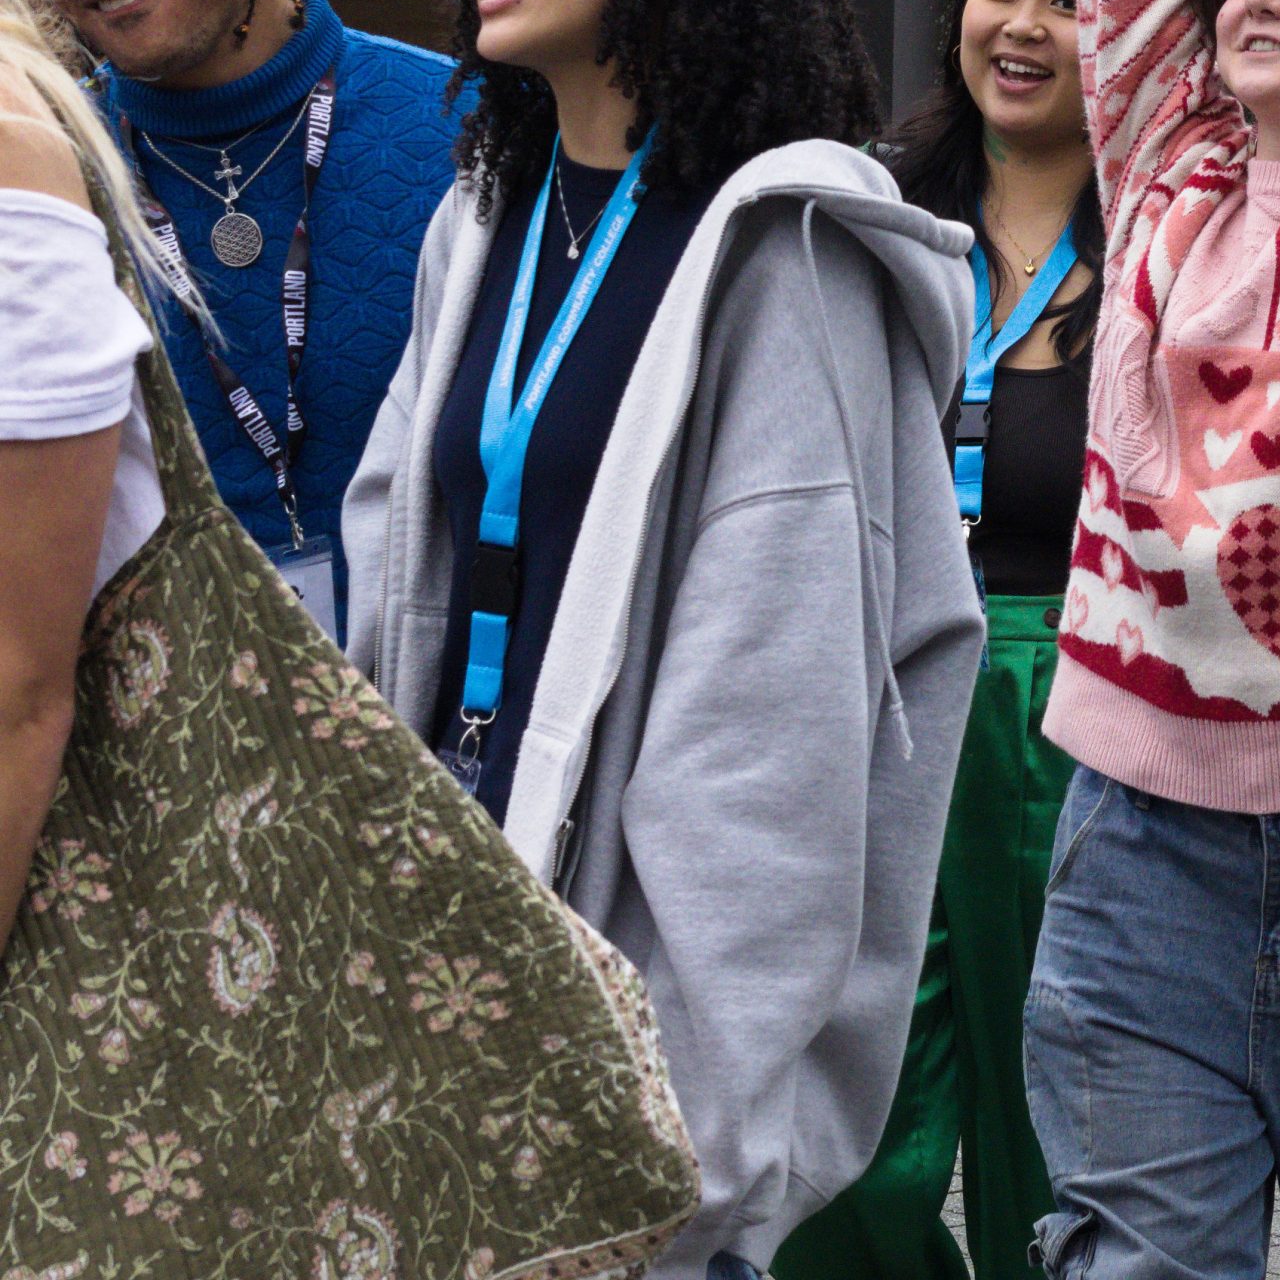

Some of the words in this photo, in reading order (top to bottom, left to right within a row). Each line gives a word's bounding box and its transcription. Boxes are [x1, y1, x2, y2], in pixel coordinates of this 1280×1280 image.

[306, 94, 333, 168] PORTLAND
[284, 270, 307, 347] PORTLAND
[524, 344, 562, 410] PORTLAND
[557, 268, 598, 344] COMMUNITY
[593, 214, 625, 269] COLLEGE
[228, 386, 280, 459] PORTLAND
